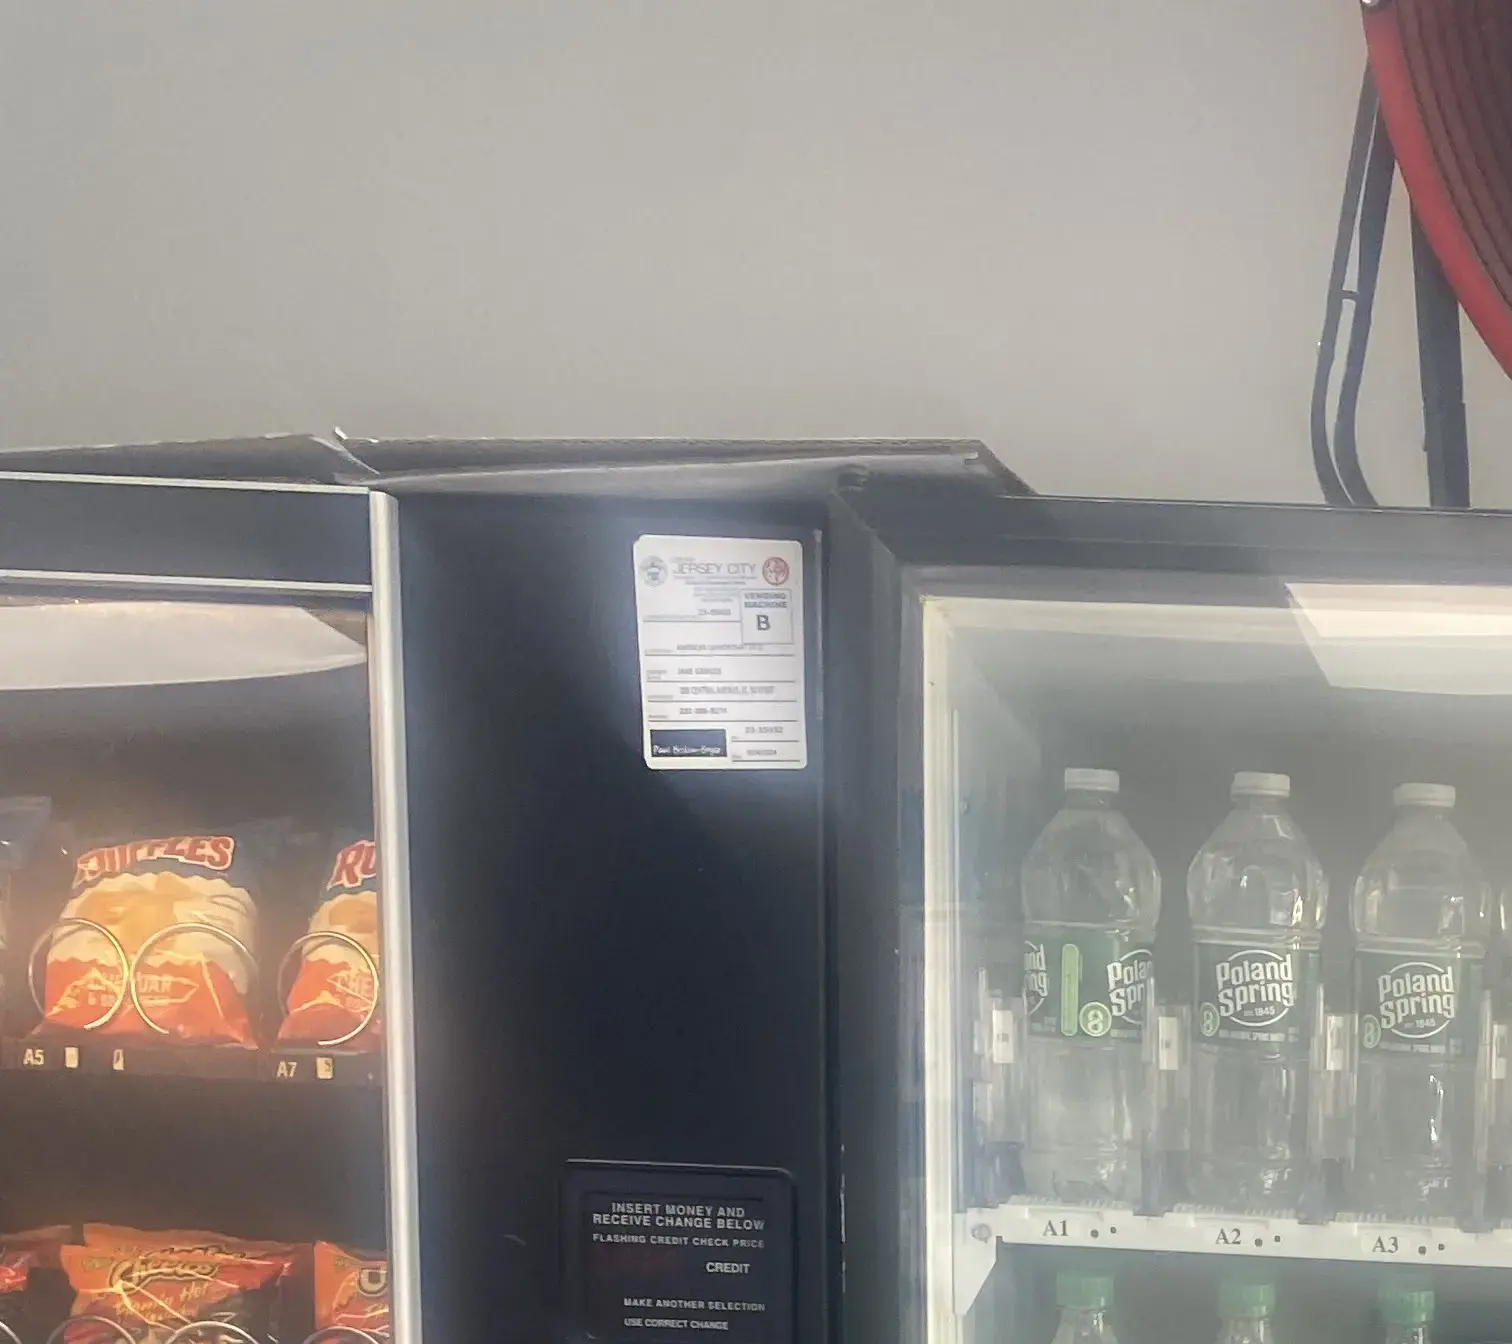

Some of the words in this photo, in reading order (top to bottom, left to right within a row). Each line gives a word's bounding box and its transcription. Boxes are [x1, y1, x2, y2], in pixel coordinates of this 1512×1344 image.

[673, 563, 721, 574] JERSEY
[728, 563, 756, 574] CITY
[1216, 954, 1292, 986] Poland
[1378, 966, 1454, 999] Poland
[1218, 980, 1294, 1016] Spring
[1380, 993, 1456, 1029] Spring
[612, 1203, 660, 1214] INSERT
[665, 1204, 712, 1216] MONEY
[717, 1207, 745, 1217] AND
[593, 1214, 650, 1226] RECEIVE
[656, 1217, 712, 1229] CHANGE
[717, 1218, 764, 1230] BELOW
[1042, 1220, 1069, 1237] A1
[593, 1234, 646, 1244] FLASHING
[650, 1235, 688, 1246] CREDIT
[692, 1237, 728, 1247] CHECK
[733, 1239, 764, 1248] PRICE
[1215, 1228, 1241, 1246] A2
[1372, 1236, 1399, 1253] A3
[706, 1262, 749, 1273] CREDIT
[624, 1299, 652, 1307] MAKE
[656, 1300, 704, 1309] ANOTHER
[708, 1302, 764, 1312] SELECTION
[624, 1319, 642, 1327] USE
[645, 1319, 688, 1329] CORRECT
[690, 1321, 728, 1330] CHANGE
